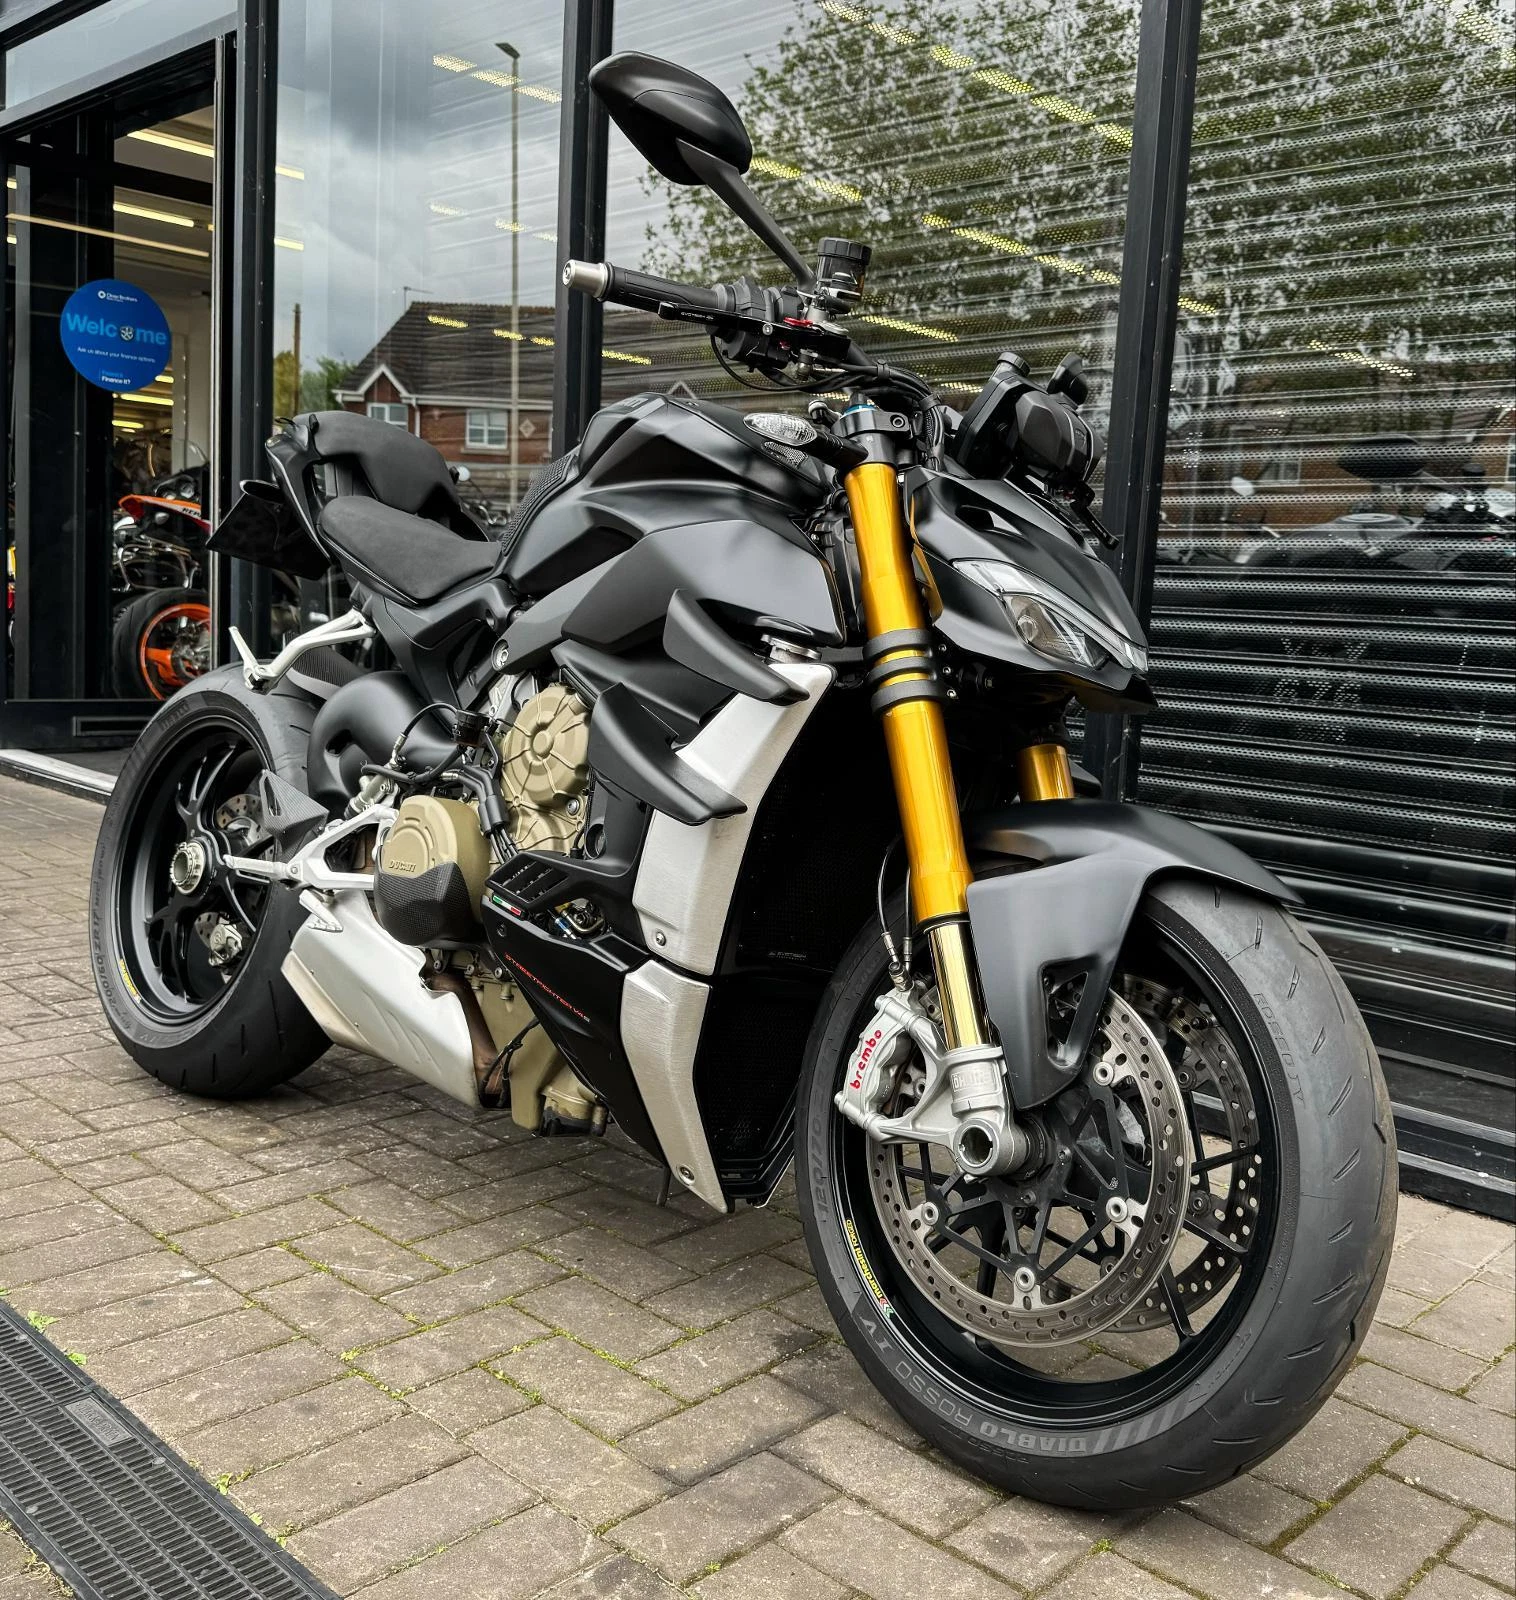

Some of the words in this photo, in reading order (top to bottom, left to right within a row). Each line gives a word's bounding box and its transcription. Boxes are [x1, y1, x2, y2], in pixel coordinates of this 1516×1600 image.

[388, 859, 417, 873] DUCATI
[849, 1029, 882, 1090] brembo
[846, 1219, 860, 1247] FORGED
[854, 1247, 883, 1299] marchesini
[860, 1315, 894, 1352] IV
[896, 1361, 974, 1427] ROSSO
[979, 1421, 1087, 1453] DIABLO
